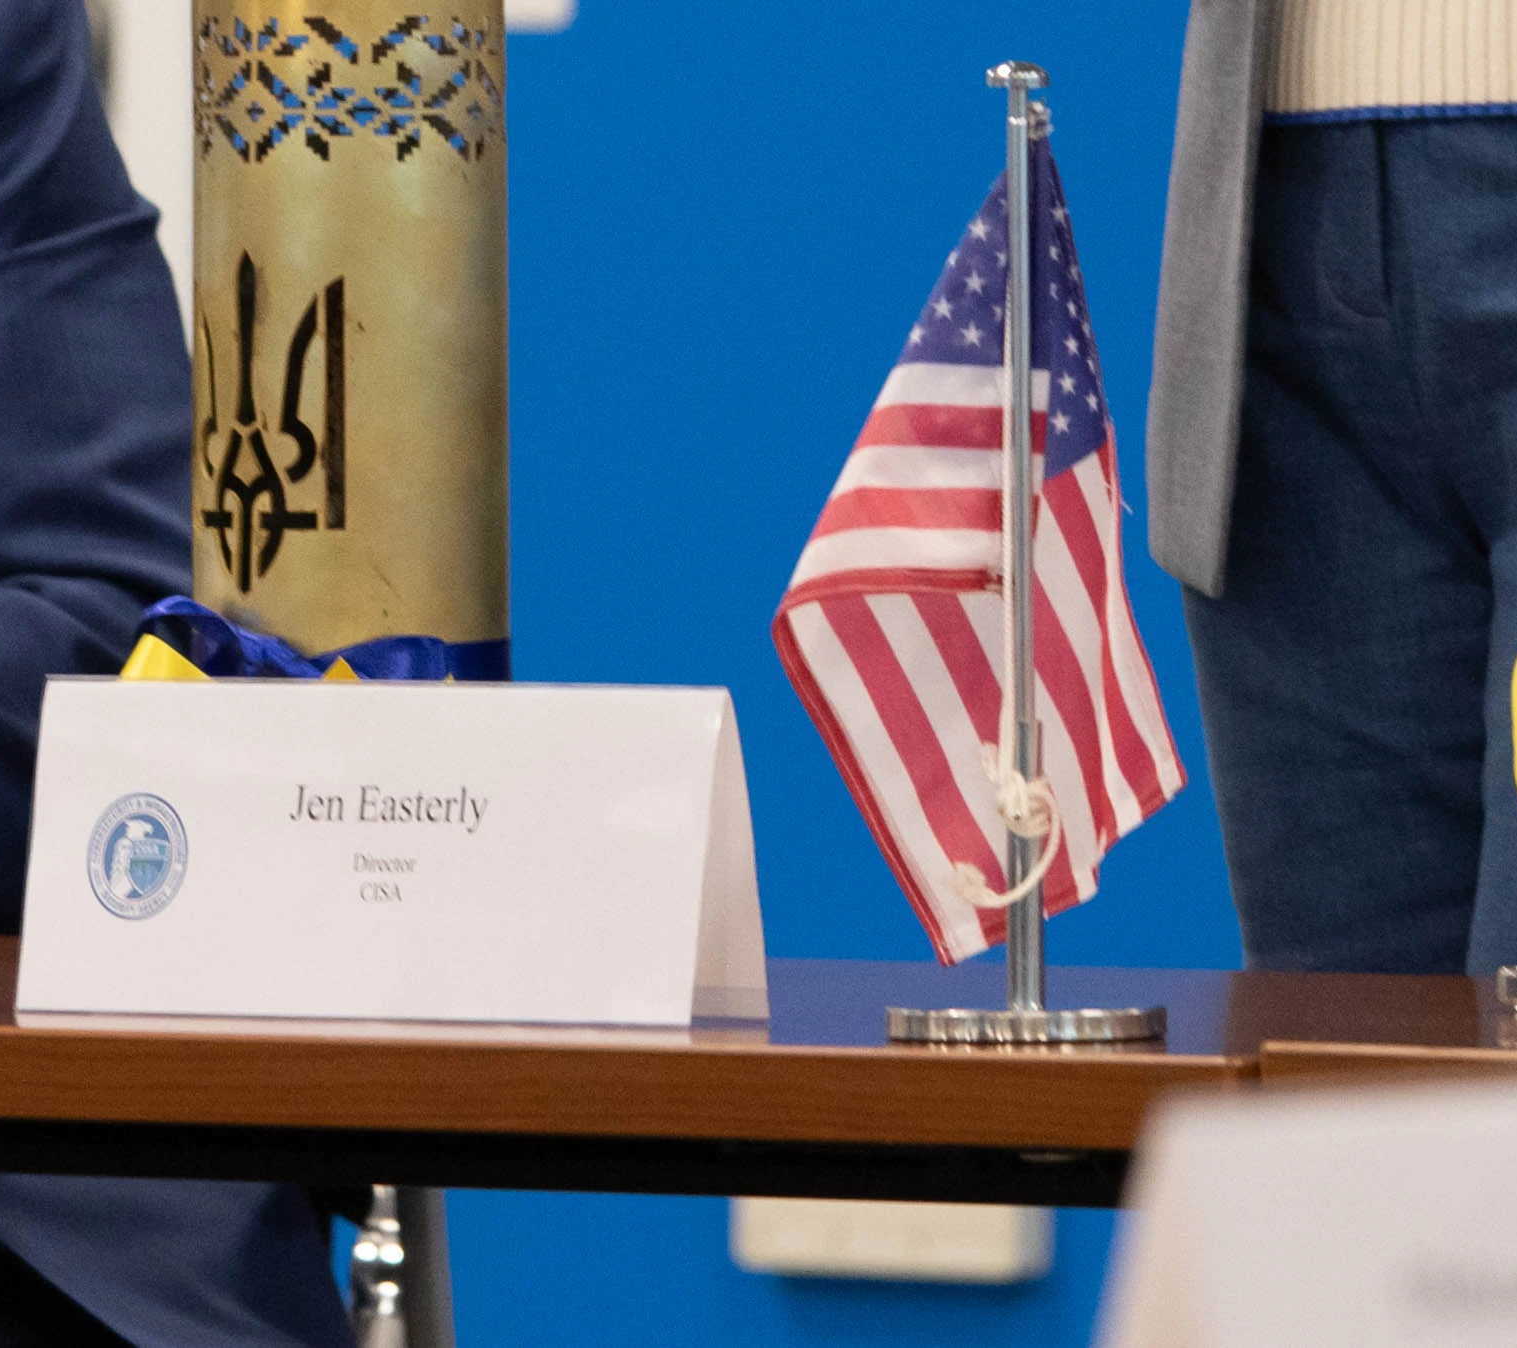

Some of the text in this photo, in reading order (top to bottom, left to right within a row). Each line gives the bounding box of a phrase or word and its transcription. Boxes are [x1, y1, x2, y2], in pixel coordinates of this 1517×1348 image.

[288, 784, 488, 833] Jen Easterly
[352, 852, 416, 873] Director
[359, 882, 403, 902] CISA
